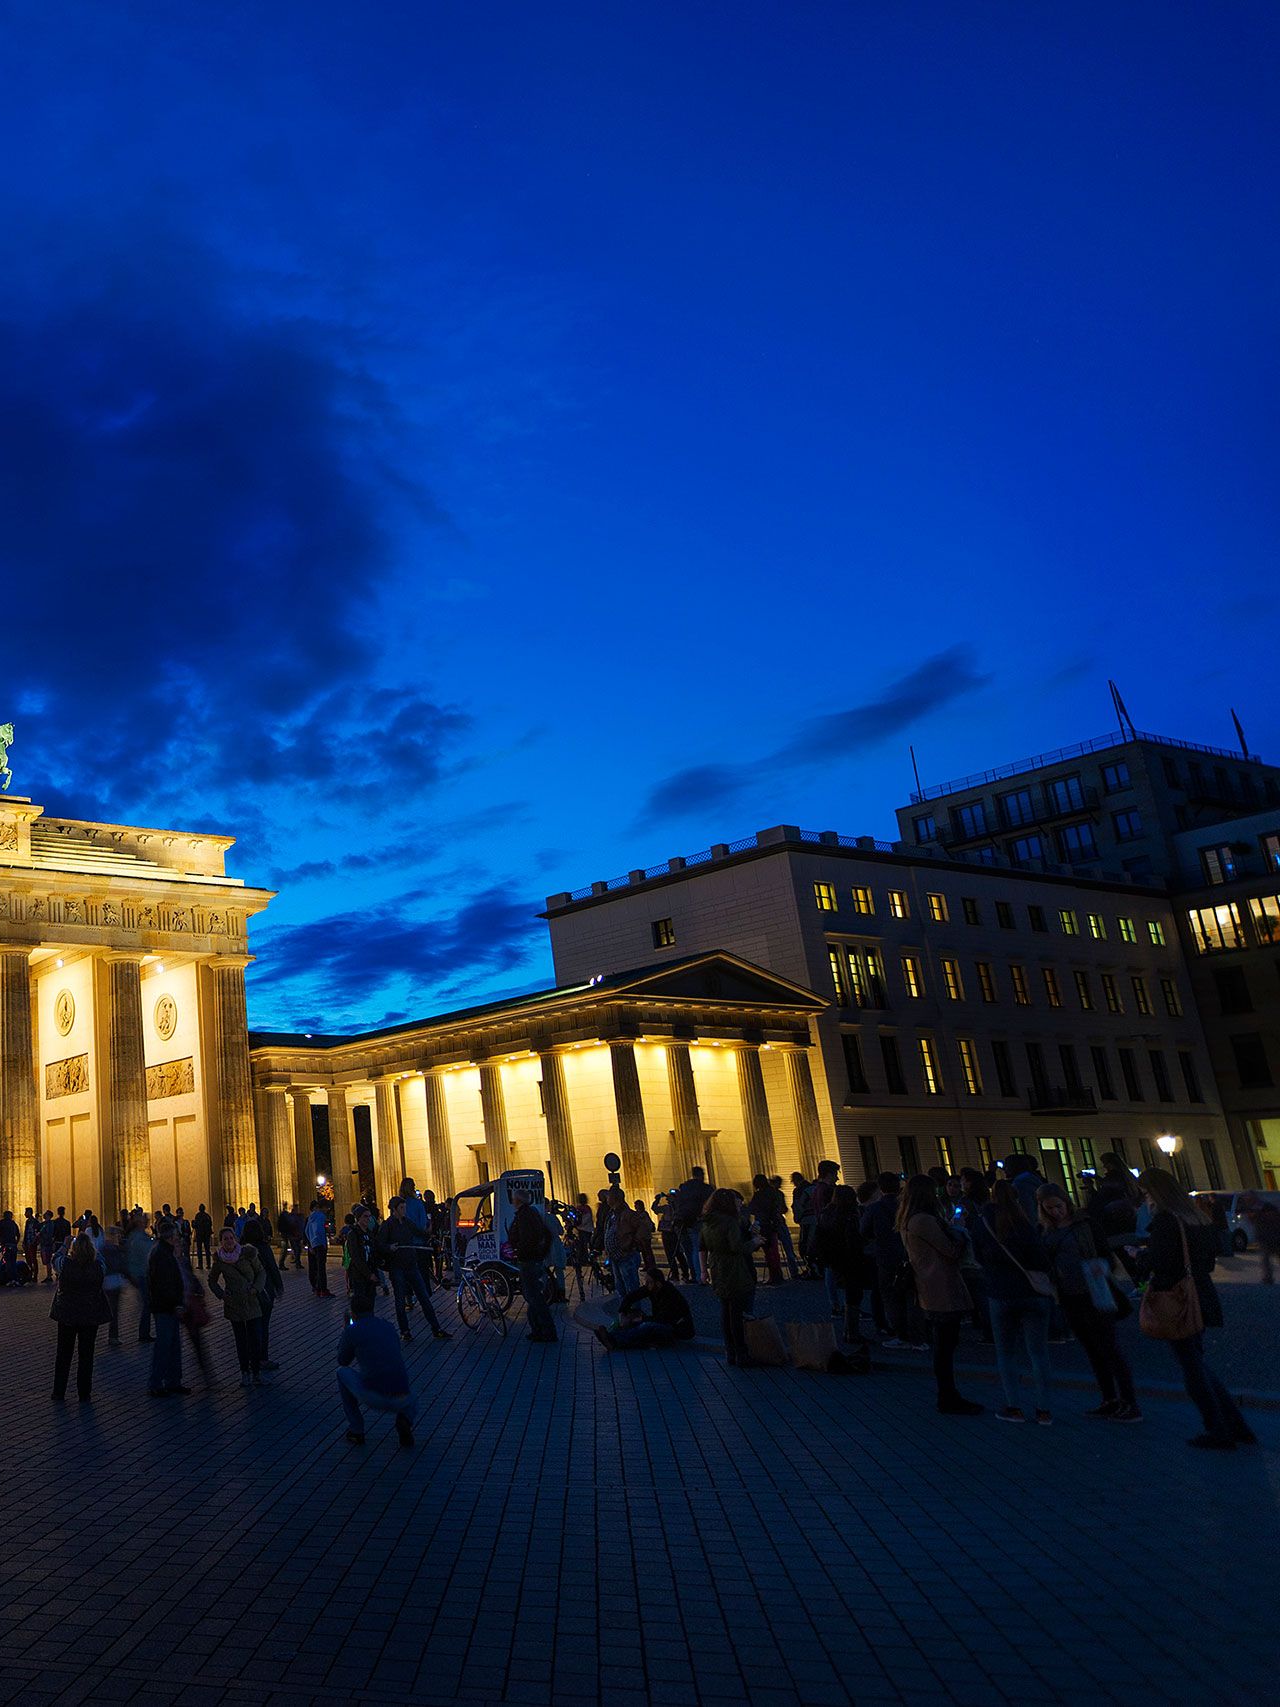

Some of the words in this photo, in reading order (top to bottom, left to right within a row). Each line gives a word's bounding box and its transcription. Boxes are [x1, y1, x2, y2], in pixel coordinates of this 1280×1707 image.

[506, 1179, 529, 1189] NOW
[477, 1233, 495, 1241] BLUE
[478, 1241, 496, 1249] MAN
